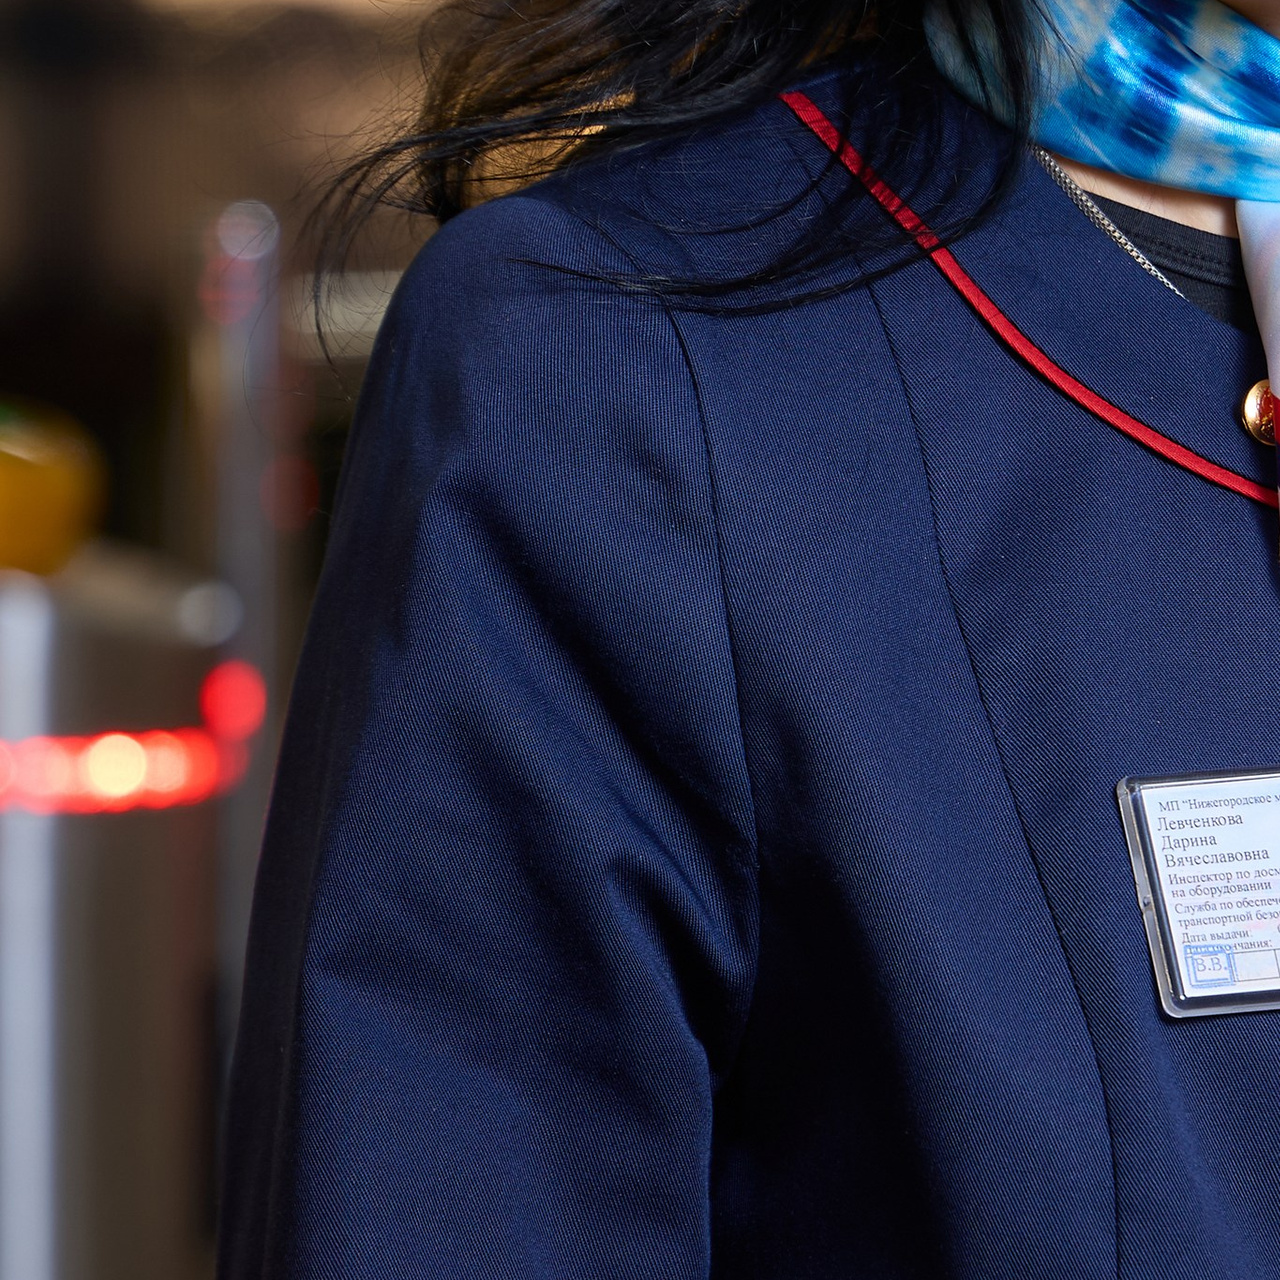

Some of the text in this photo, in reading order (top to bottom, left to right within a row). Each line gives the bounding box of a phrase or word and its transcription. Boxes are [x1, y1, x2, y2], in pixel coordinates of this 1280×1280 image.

[1158, 800, 1180, 812] МП
[1157, 814, 1243, 831] Левченкова
[1162, 835, 1217, 851] Дарина
[1164, 849, 1270, 868] Вячеславовна
[1168, 871, 1233, 885] Инспектор
[1236, 871, 1250, 880] по
[1171, 881, 1272, 898] на оборудовании
[1174, 901, 1218, 915] Служба
[1220, 902, 1233, 911] по
[1178, 912, 1253, 929] транспортной
[1182, 932, 1207, 945] Дата
[1210, 929, 1253, 941] выдачи:
